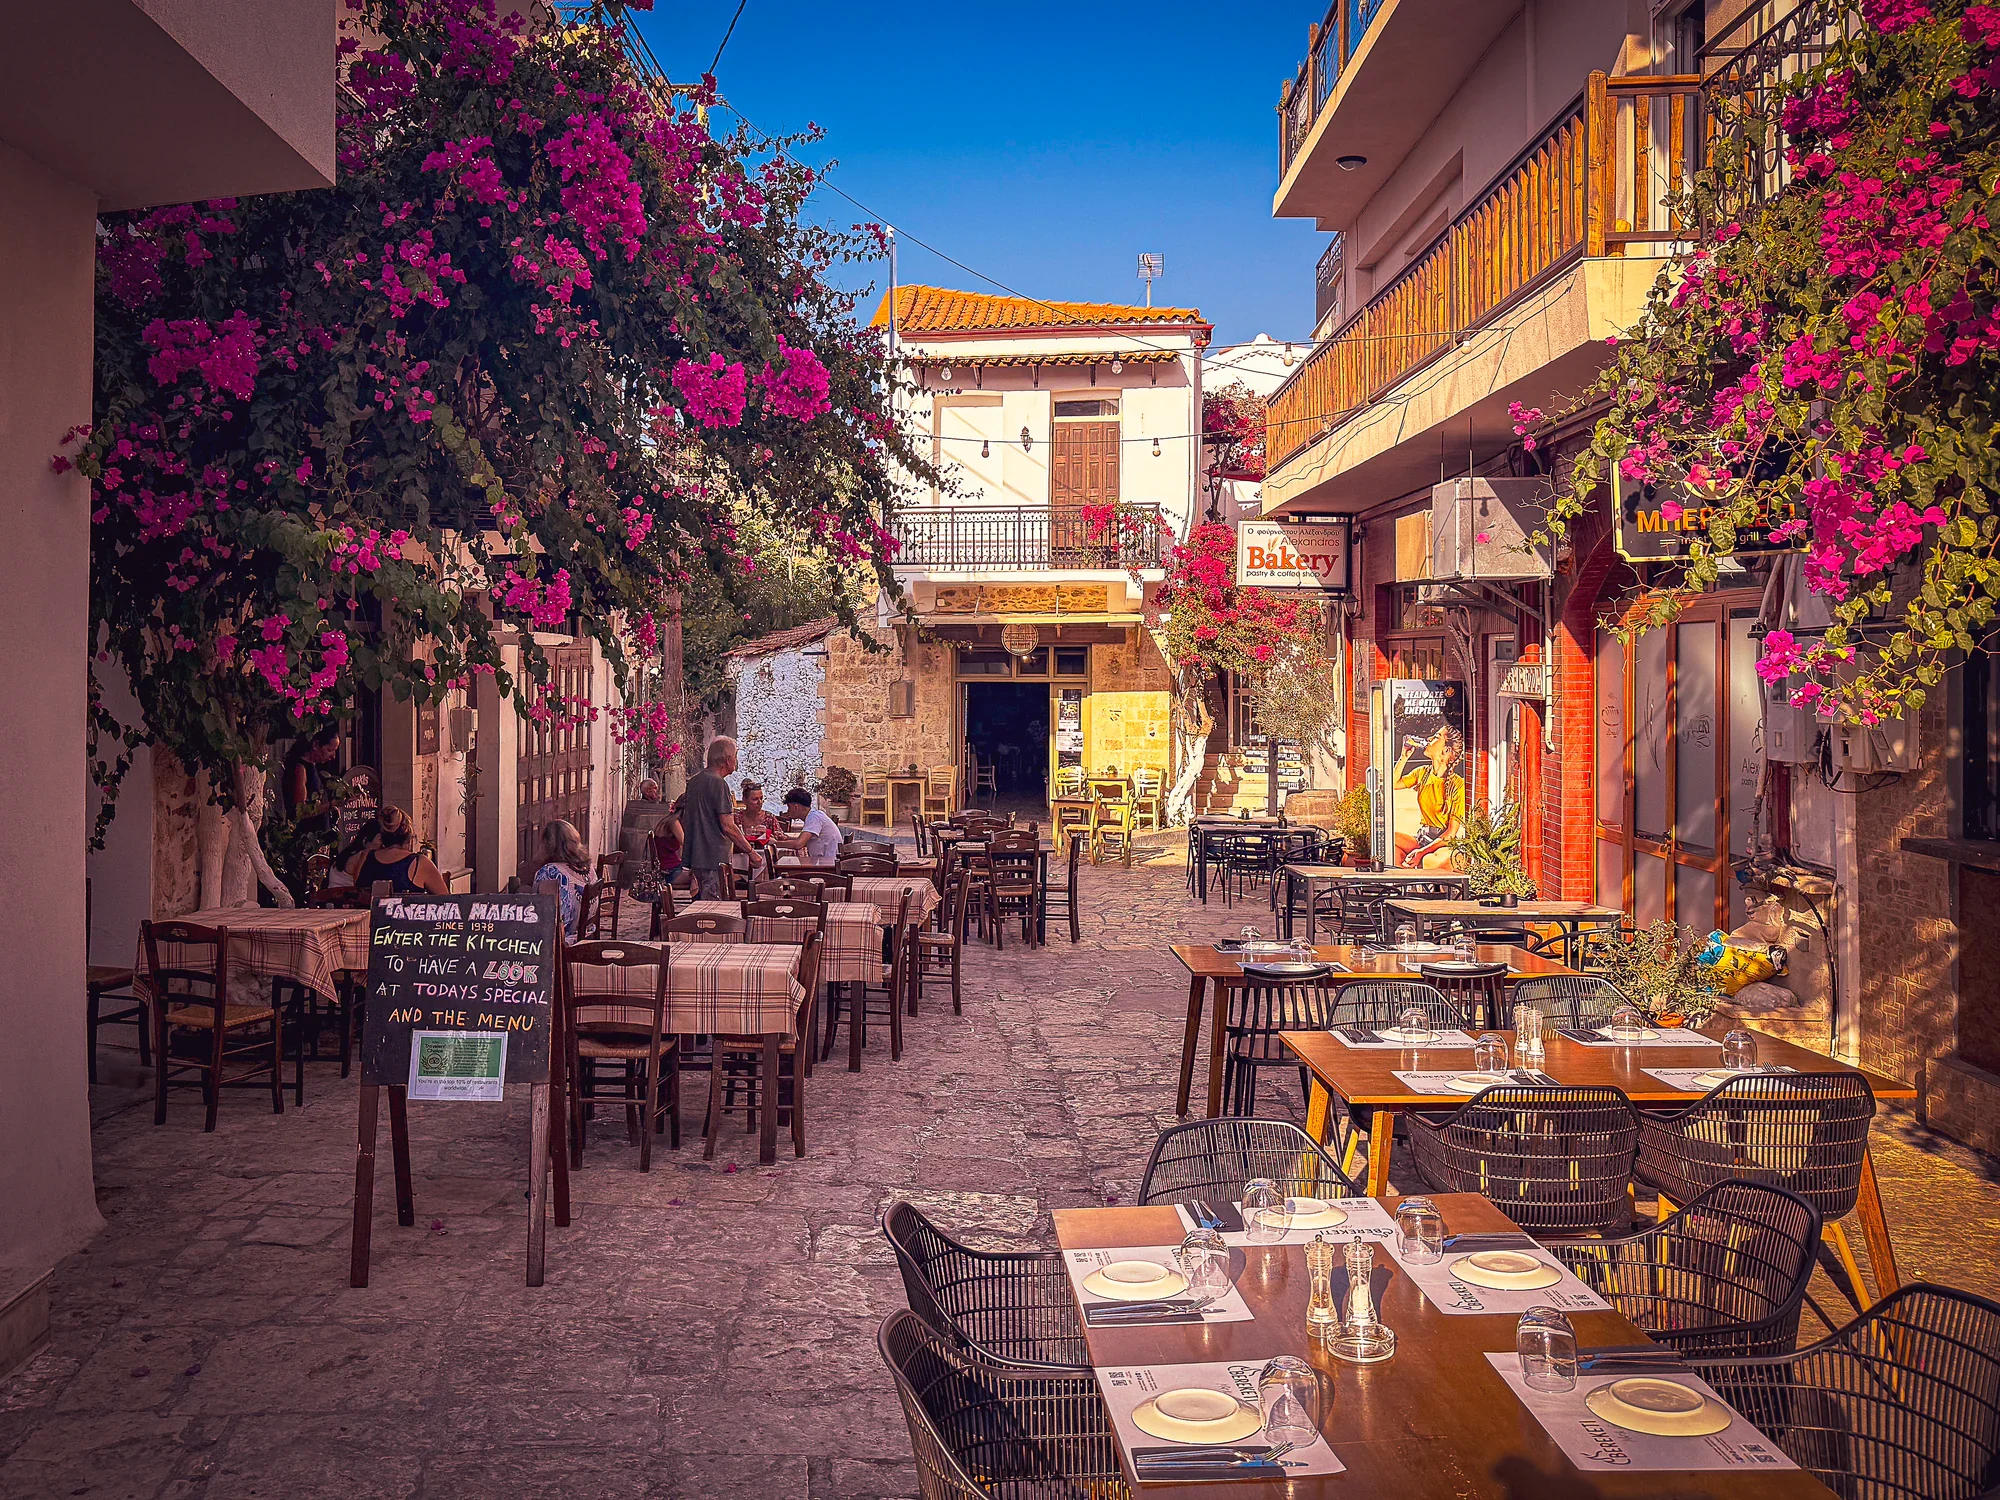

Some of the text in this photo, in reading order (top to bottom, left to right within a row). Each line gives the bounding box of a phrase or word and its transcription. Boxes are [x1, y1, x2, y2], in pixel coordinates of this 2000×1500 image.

[1280, 536, 1340, 546] Alexandros
[1740, 531, 1759, 544] grill
[1246, 569, 1268, 577] pastry
[1276, 569, 1301, 577] coffee
[1302, 569, 1321, 578] shop
[1247, 546, 1340, 578] Bakery
[378, 897, 539, 923] TAVERNA MAKIS
[433, 922, 495, 933] SINCE 1978
[374, 926, 543, 956] ENTER THE KITCHEN
[384, 954, 540, 986] TO HAVE A LOOK
[375, 982, 548, 1005] AT TODAYS SPECIAL
[388, 1006, 535, 1031] AND THE MENU
